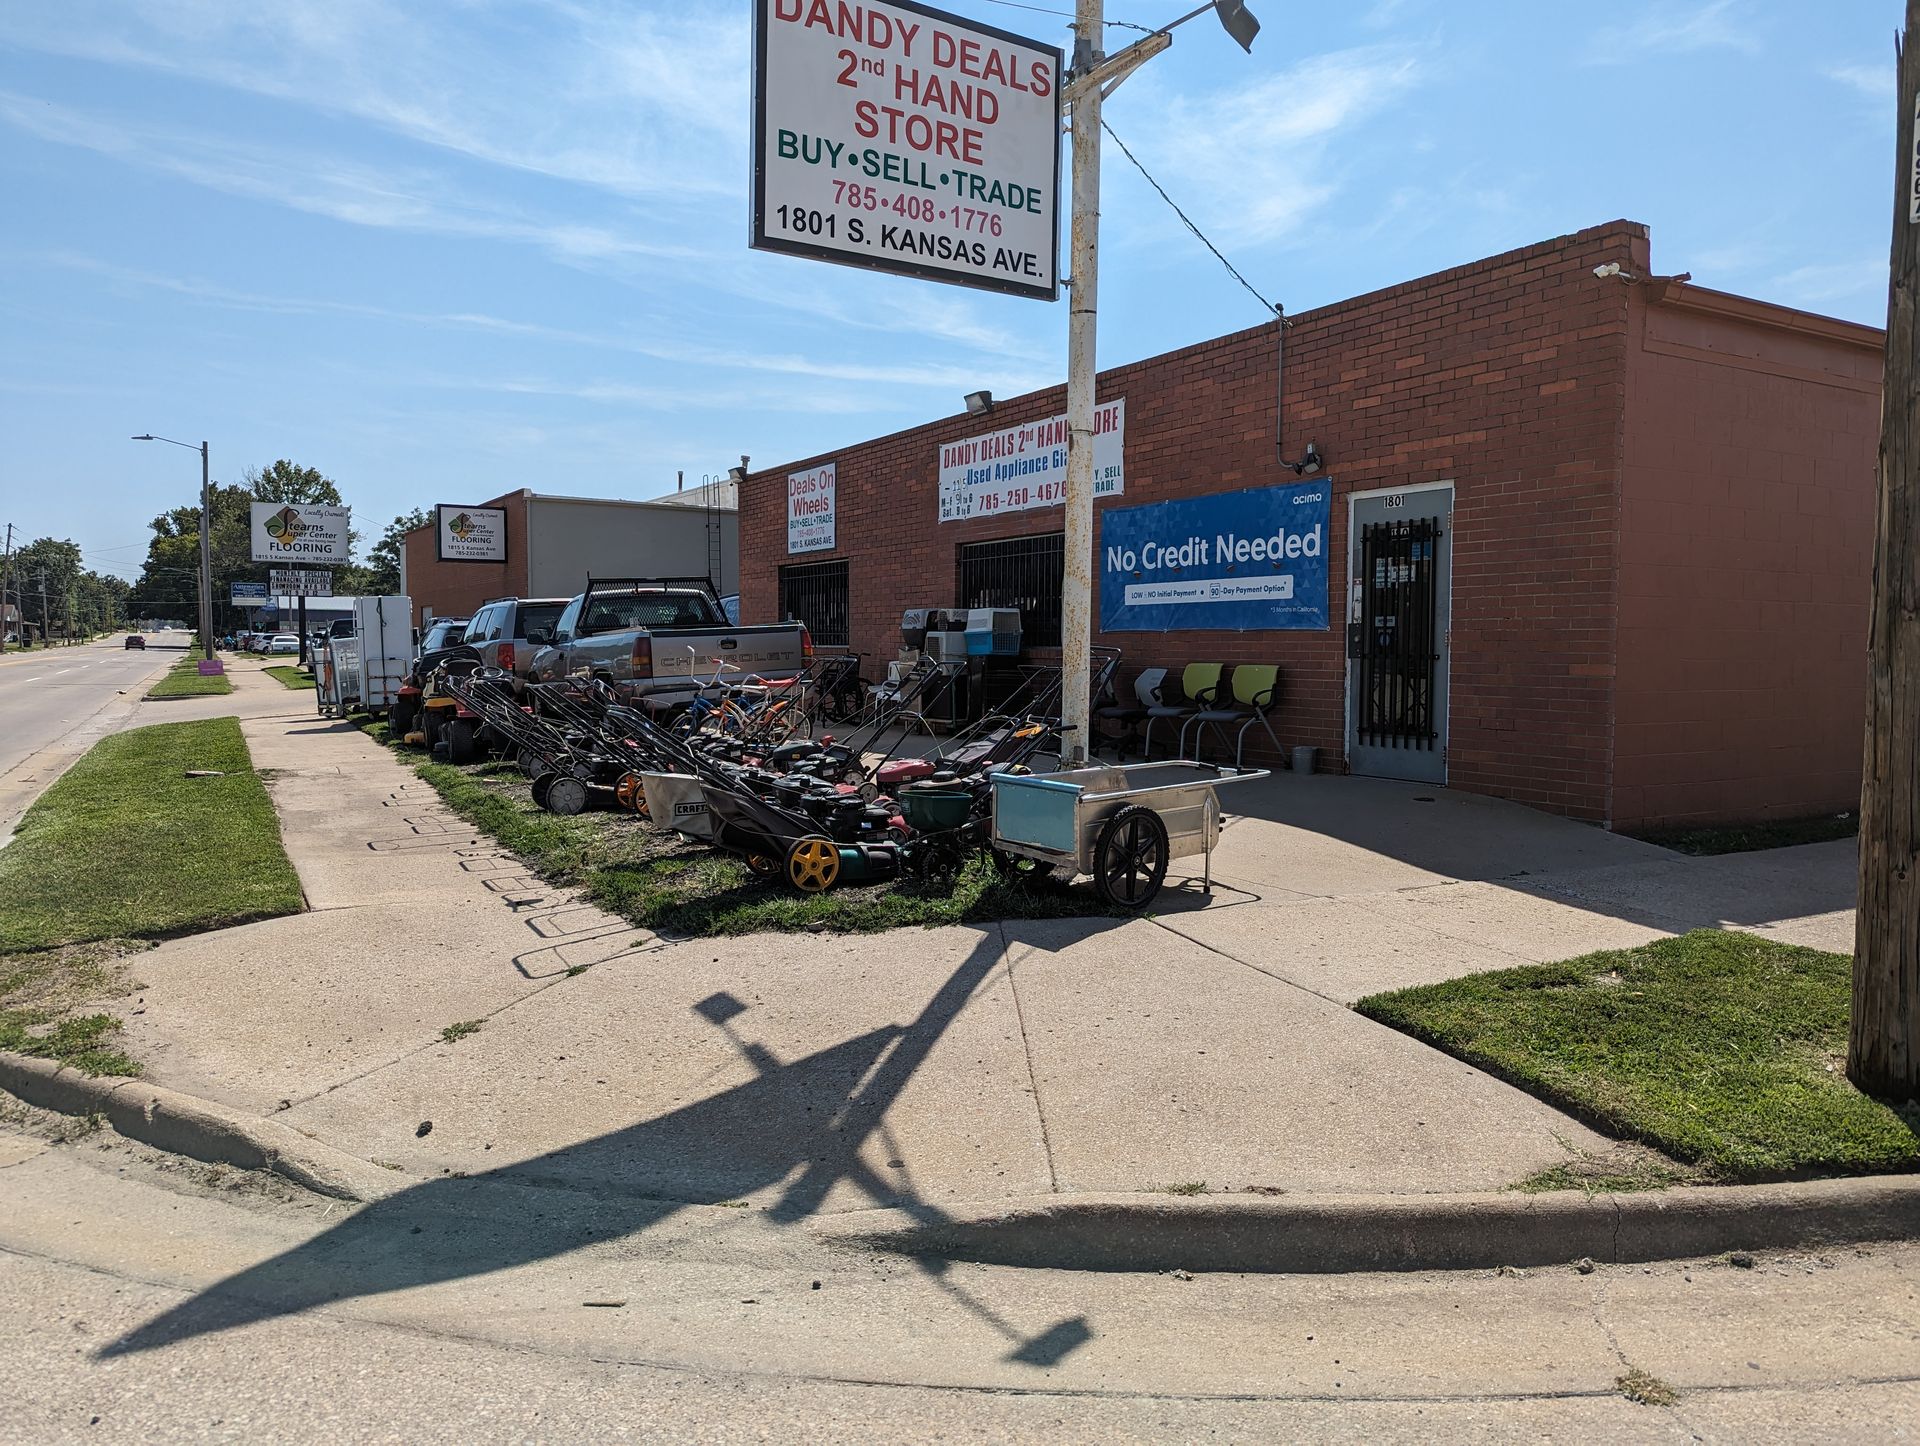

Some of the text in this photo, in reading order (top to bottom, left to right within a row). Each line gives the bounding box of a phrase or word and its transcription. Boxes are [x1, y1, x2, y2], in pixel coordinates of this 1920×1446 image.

[775, 0, 1051, 97] DANDY DEALS
[837, 49, 998, 124] 2nd HAND
[855, 100, 983, 166] STORE
[777, 204, 1043, 278] 1801 S. KANSAS AVE.
[944, 442, 978, 469] DANDY
[981, 433, 1014, 461] DEALS
[1018, 428, 1034, 454] 2nd
[1094, 407, 1118, 435] ORE
[967, 465, 991, 485] Used
[995, 456, 1048, 482] Appliance
[1105, 465, 1121, 479] SELL
[790, 470, 834, 497] Deals On
[793, 493, 829, 517] Wheels
[1384, 495, 1405, 507] 1801
[270, 542, 332, 553] FLOORING
[451, 536, 492, 544] FLOORING
[804, 537, 822, 547] KANSAS
[1107, 523, 1321, 573] No Credit Needed
[1148, 590, 1156, 598] NO
[1174, 589, 1197, 598] Payment
[1235, 586, 1262, 595] Payment
[660, 651, 794, 667] CHEVROLET
